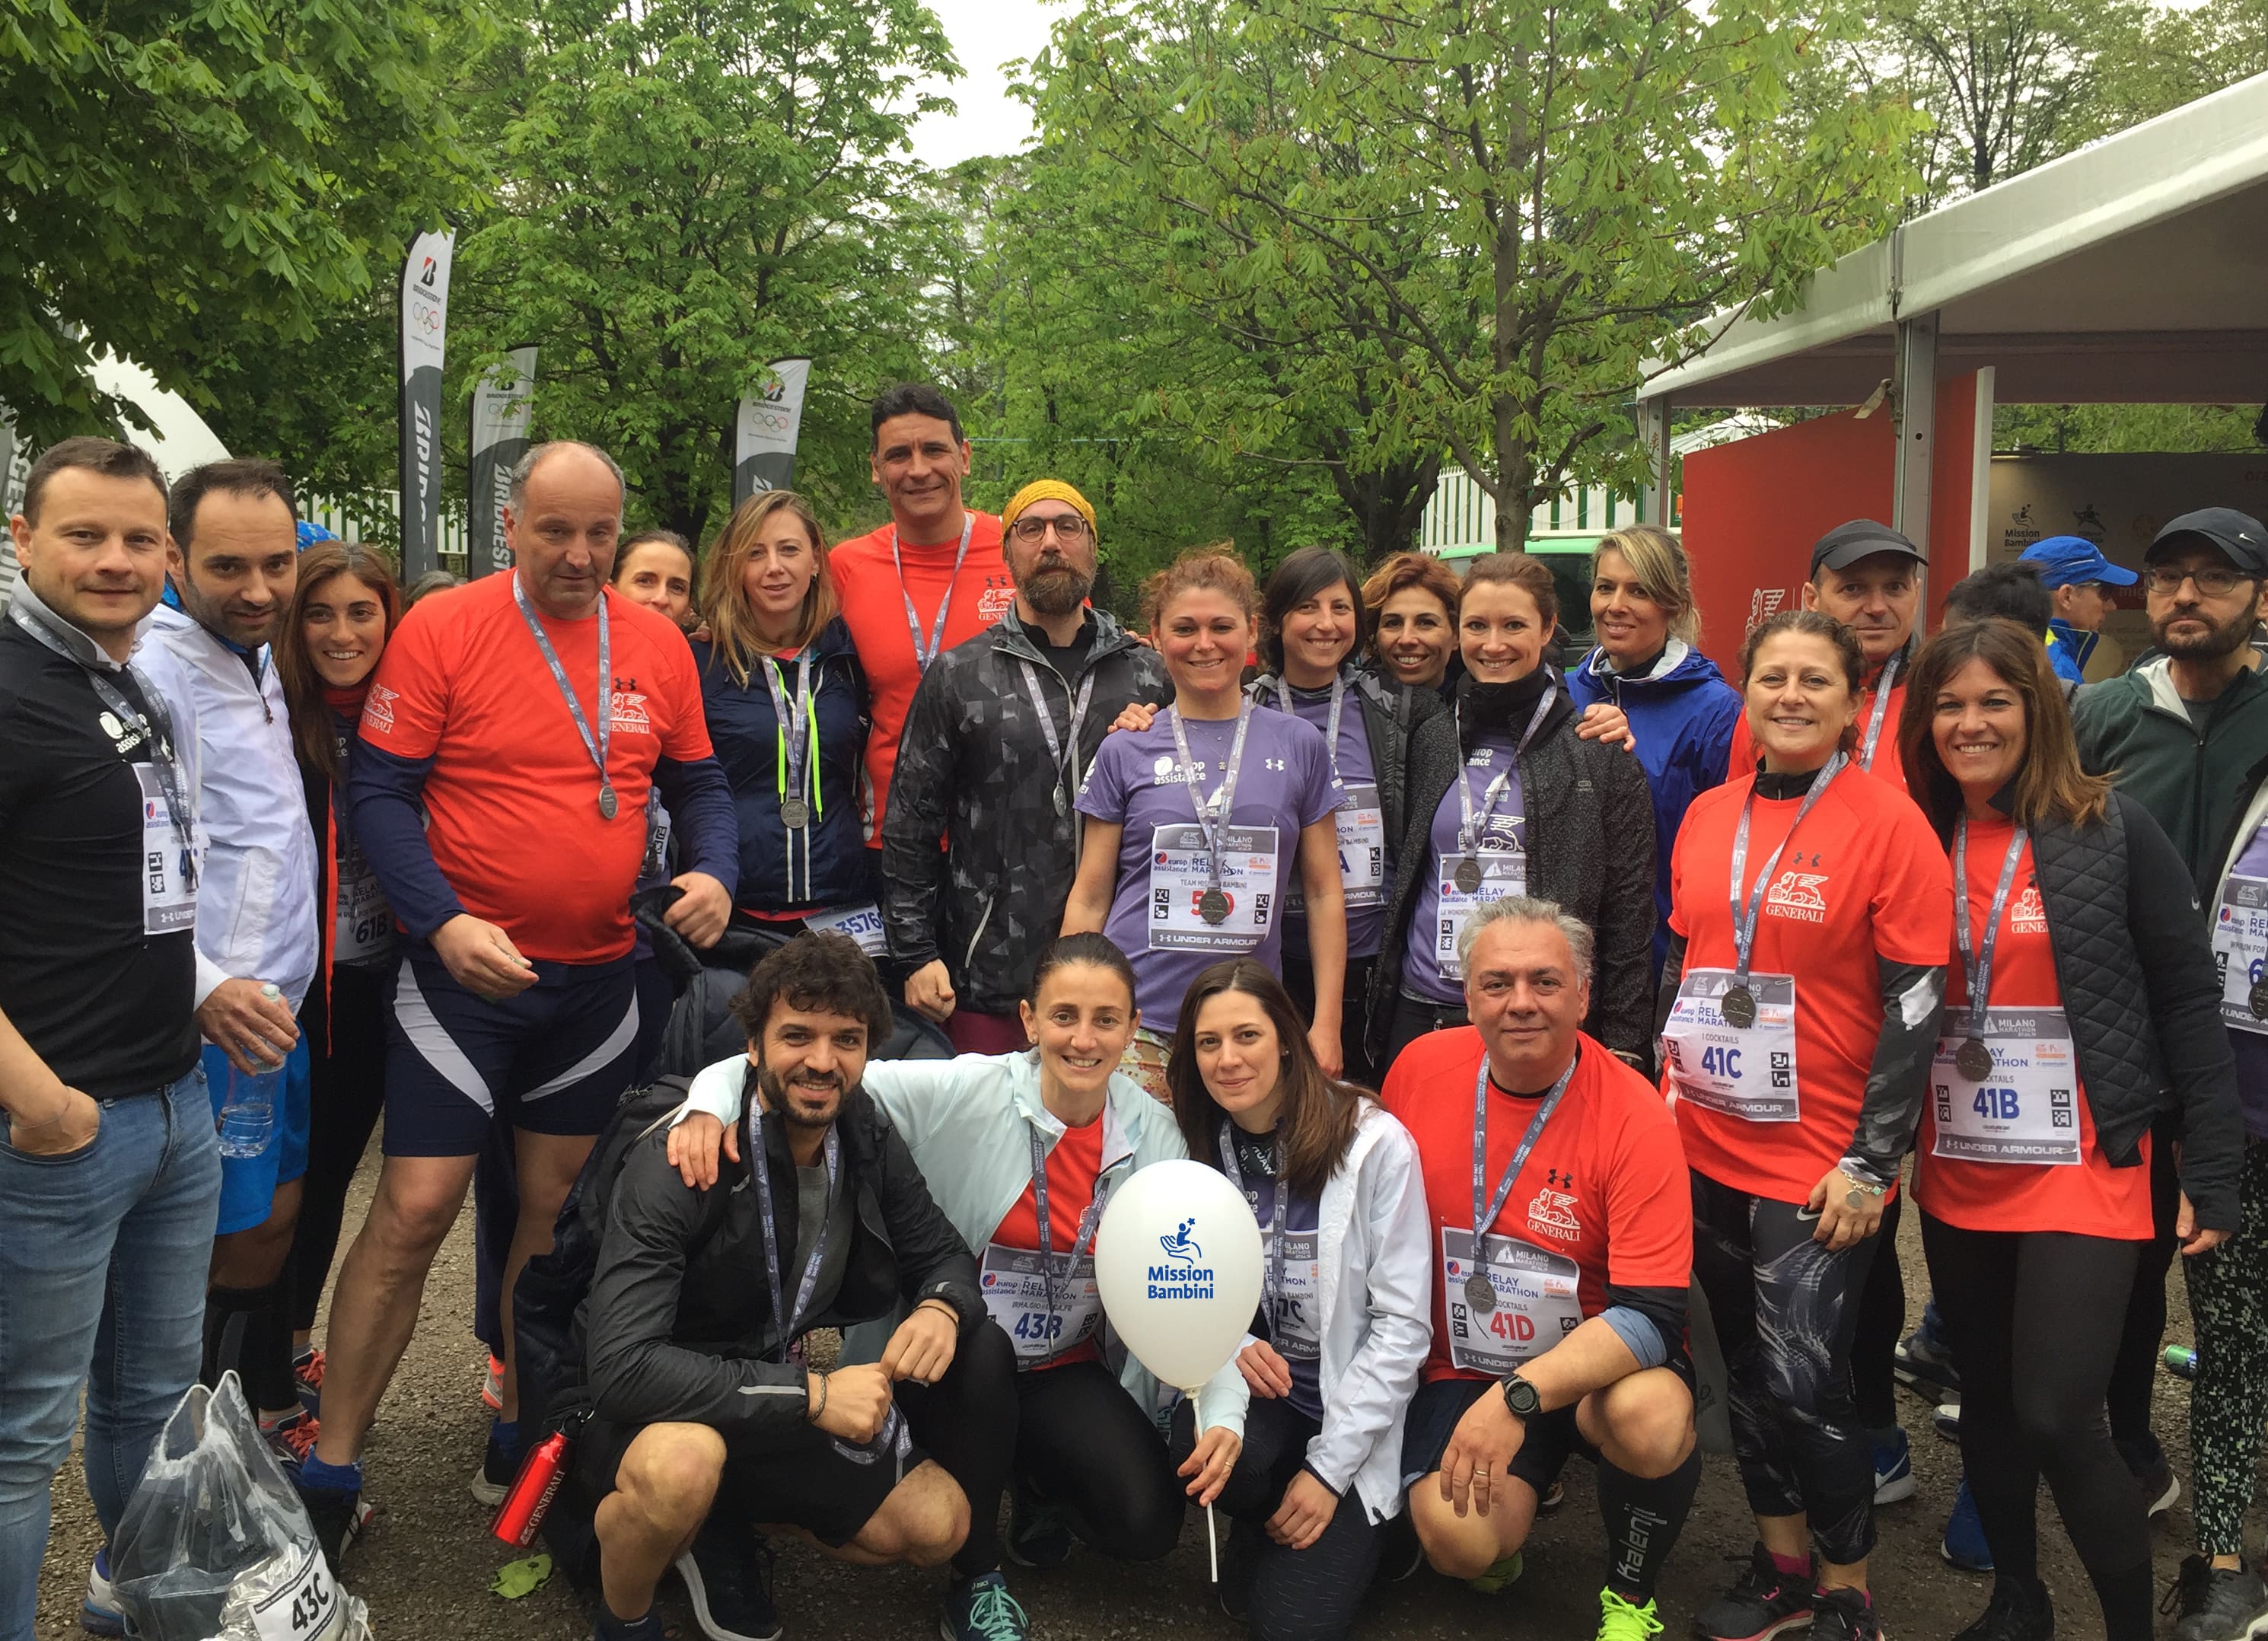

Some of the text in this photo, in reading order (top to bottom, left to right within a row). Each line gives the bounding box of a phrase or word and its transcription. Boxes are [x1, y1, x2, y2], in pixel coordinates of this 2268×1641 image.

[2005, 529, 2040, 537] Mission
[1174, 761, 1206, 772] eop
[1153, 865, 1188, 873] assistance
[1168, 859, 1188, 869] europ
[1180, 879, 1196, 887] TEAM
[1766, 903, 1825, 923] GENERALI
[355, 913, 388, 944] 61B
[1174, 935, 1210, 945] UNDER
[2253, 945, 2266, 953] FOR
[1999, 1019, 2036, 1028] MILANO
[1706, 1034, 1740, 1044] COCKTAILS
[1701, 1046, 1743, 1079] 41C
[1729, 1101, 1782, 1112] ARMOUR
[1973, 1087, 2020, 1119] 41B
[1960, 1142, 2060, 1155] UNDER ARMOUR
[1527, 1219, 1581, 1241] GENERALI
[1516, 1251, 1550, 1263] MILANO
[1148, 1265, 1214, 1281] Mission
[996, 1280, 1018, 1289] europ
[1022, 1280, 1061, 1292] RELY
[1148, 1283, 1214, 1299] Bambini
[1015, 1312, 1063, 1340] 43B
[1490, 1311, 1535, 1341] 41D
[1478, 1357, 1518, 1368] UNDER
[529, 1470, 565, 1528] GENERALI
[292, 1572, 329, 1631] 43C
